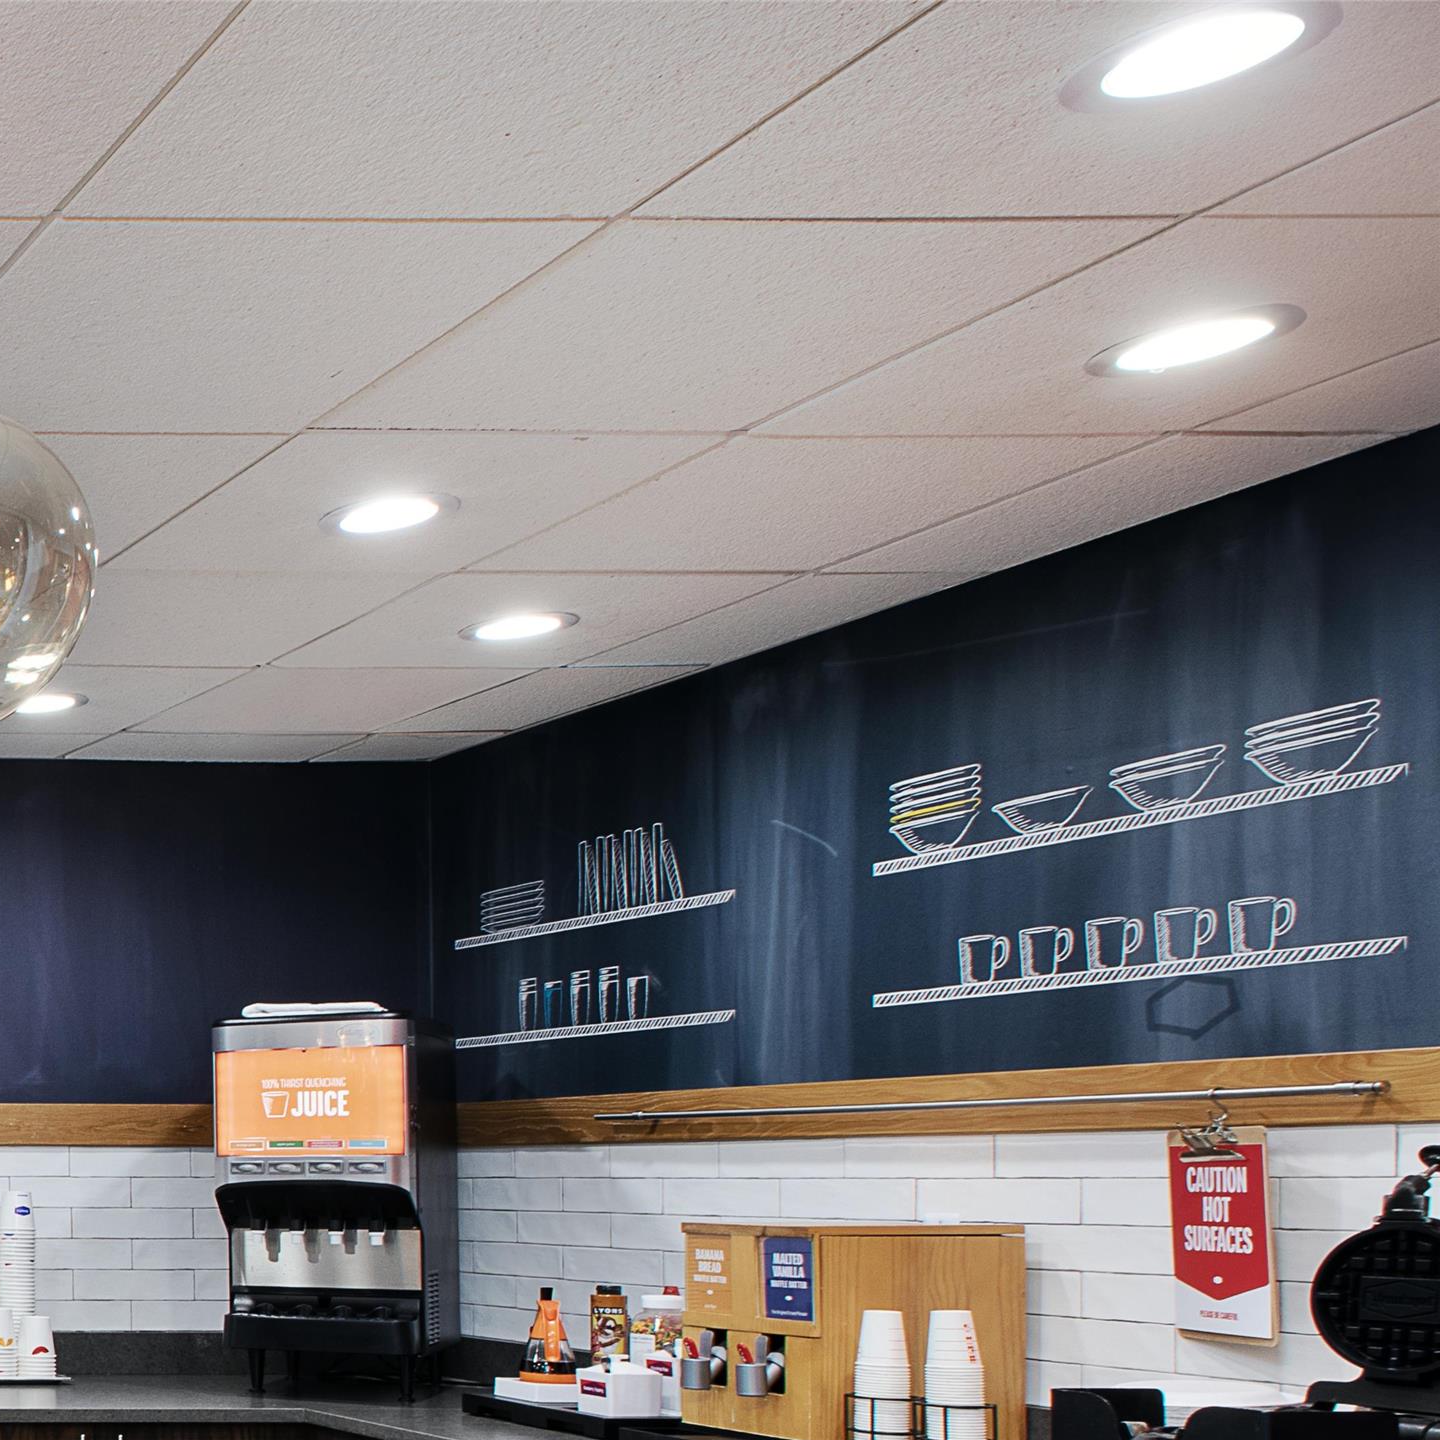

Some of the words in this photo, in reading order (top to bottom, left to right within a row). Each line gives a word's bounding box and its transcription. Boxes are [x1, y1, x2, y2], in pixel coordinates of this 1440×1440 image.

[261, 1080, 280, 1088] 100%
[280, 1078, 304, 1088] THIRST
[305, 1077, 346, 1088] QUENCHING
[291, 1090, 350, 1117] JUICE
[1186, 1166, 1247, 1194] CAUTION
[1201, 1196, 1231, 1223] HOT
[1183, 1225, 1254, 1255] SURFACES
[695, 1248, 724, 1261] BANANA
[772, 1253, 804, 1265] MALTED
[698, 1261, 721, 1273] BREAD
[772, 1265, 805, 1278] VANILLA
